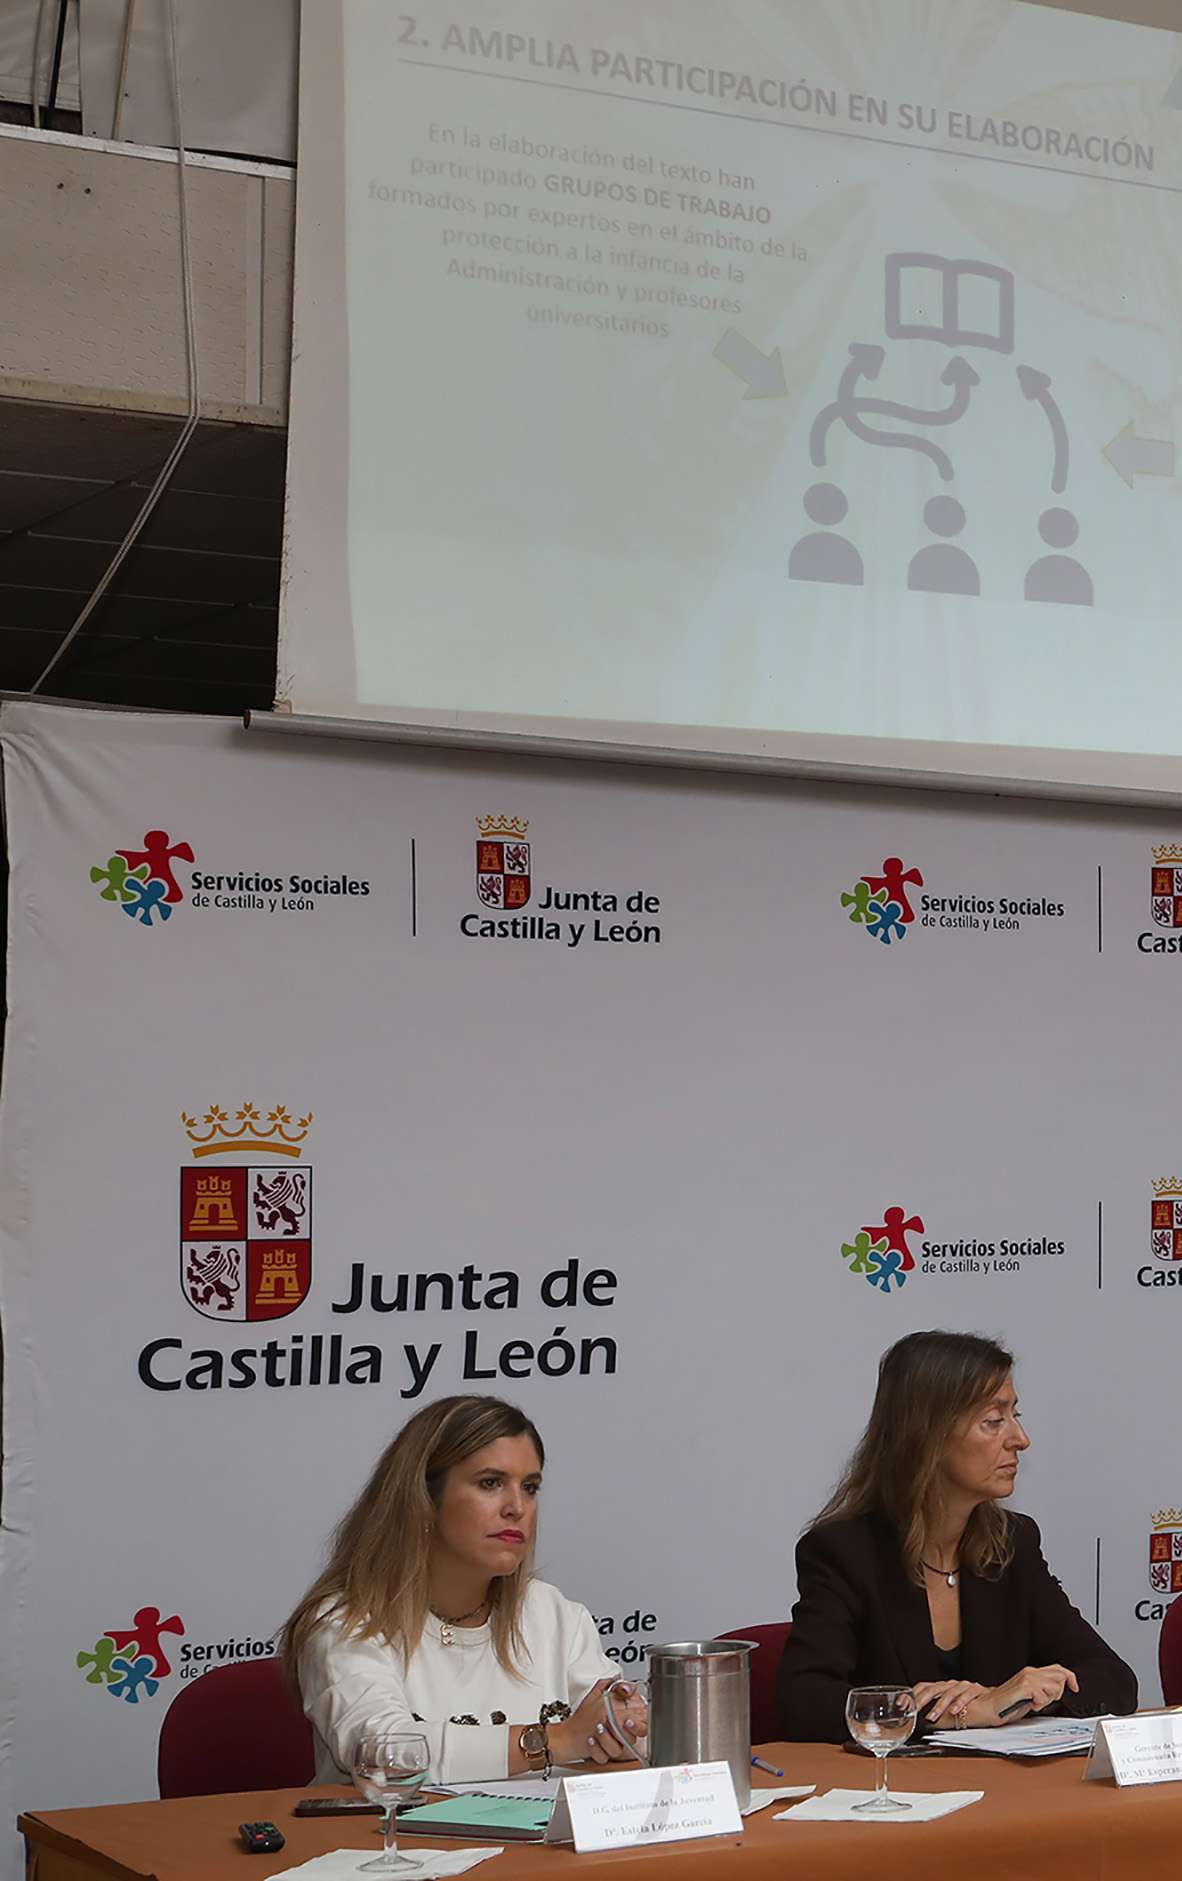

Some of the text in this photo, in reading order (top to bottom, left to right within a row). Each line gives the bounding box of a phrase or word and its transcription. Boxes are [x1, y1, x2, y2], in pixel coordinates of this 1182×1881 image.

[398, 15, 1154, 171] 2. AMPLIA PARTICIPACIÓN EN SU ELABORACIÓN
[429, 123, 755, 191] En la elaboración del texto han
[410, 155, 771, 224] participado GRUPOS DE TRABAJO
[368, 179, 807, 261] formados por expertos en el ámbito de la
[442, 227, 745, 283] protección a la infancia de la
[447, 258, 742, 314] Administración y profesores
[527, 305, 669, 337] universitarios
[191, 870, 370, 897] Servicios Sociales
[192, 894, 314, 913] de Castilla y León
[538, 888, 660, 914] Junta de
[922, 895, 1064, 917] Servicios Sociales
[460, 913, 661, 946] Castilla y León
[922, 914, 1019, 932] de Castilla y León
[922, 1237, 1065, 1258] Servicios Sociales
[922, 1258, 1020, 1274] de Castilla y León
[332, 1258, 618, 1314] Junta de
[138, 1327, 618, 1399] Castilla y León
[623, 1610, 656, 1633] de
[180, 1638, 274, 1662] Servicios
[180, 1665, 198, 1679] de
[652, 1822, 679, 1835] López
[682, 1817, 712, 1828] García
